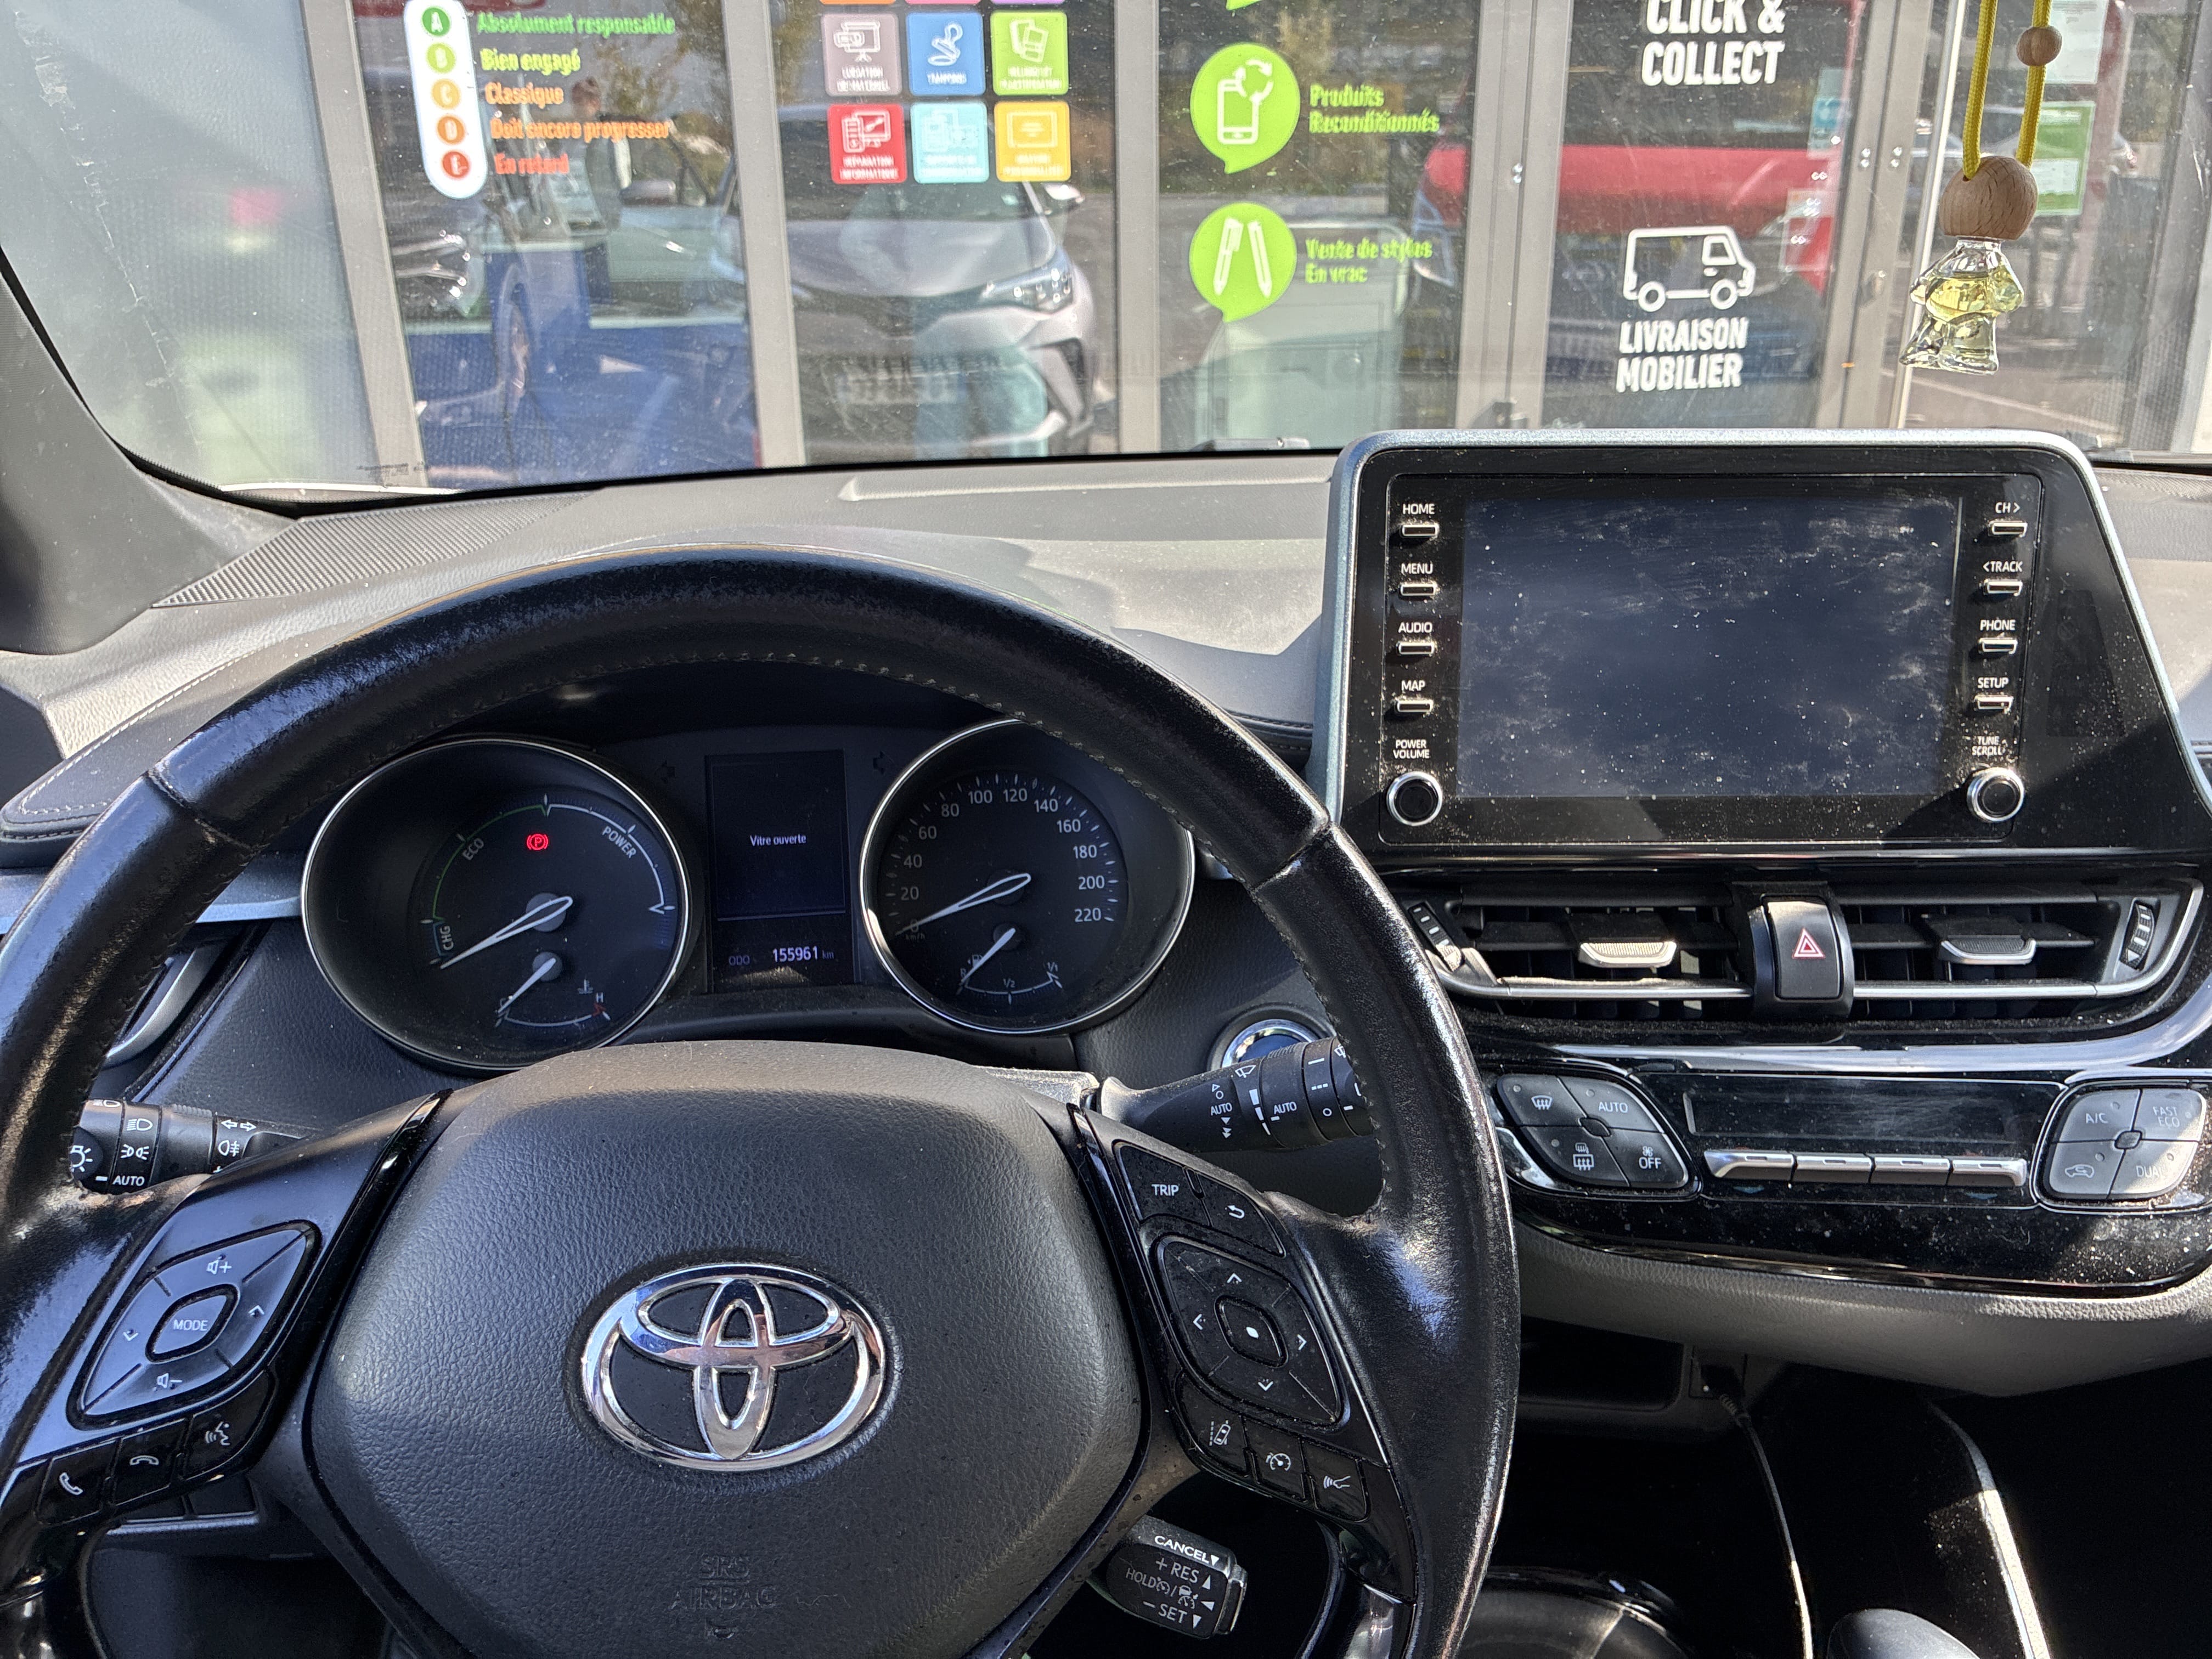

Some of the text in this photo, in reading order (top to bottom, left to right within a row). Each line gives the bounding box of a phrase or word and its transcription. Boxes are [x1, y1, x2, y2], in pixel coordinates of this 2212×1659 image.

[431, 11, 443, 32] A
[1646, 0, 1786, 34] CLICK &
[478, 12, 675, 38] Absolument responsable
[480, 48, 580, 76] Bien engagé
[1641, 41, 1786, 86] COLLECT
[485, 82, 564, 109] Classique
[1310, 83, 1384, 107] Produits
[1309, 108, 1440, 133] Reconditionnés
[490, 117, 669, 143] Doit encore progresser
[495, 153, 569, 174] En retard
[1306, 238, 1354, 259] Vente
[1357, 238, 1379, 259] de
[1306, 265, 1368, 284] En vrac
[1620, 317, 1750, 354] LIVRAISON
[1616, 353, 1743, 393] MOBILIER
[1402, 504, 1435, 515] HOME
[1995, 502, 2011, 514] CH
[1401, 563, 1434, 574] MENU
[1398, 622, 1433, 633] AUDIO
[1980, 619, 2016, 631] PHONE
[1401, 680, 1426, 692] MAP
[1978, 677, 2009, 689] SETUP
[1395, 739, 1426, 749] POWER
[1977, 736, 1999, 746] TUNE
[1393, 749, 1430, 759] VOLUME
[1972, 746, 2002, 756] SCROLL
[968, 789, 993, 804] 100
[1003, 788, 1028, 803] 120
[941, 804, 960, 817] 80
[1034, 799, 1059, 813] 140
[918, 826, 938, 840] 60
[1057, 820, 1082, 834] 160
[601, 826, 637, 860] POWER
[750, 833, 806, 847] Vitre ouverte
[462, 838, 485, 861] ECO
[1073, 845, 1098, 859] 180
[904, 854, 923, 869] 40
[1078, 876, 1105, 890] 200
[900, 887, 919, 901] 20
[1075, 909, 1102, 922] 220
[441, 926, 454, 951] CHG
[729, 946, 834, 966] ODO 155961 km
[1003, 978, 1015, 988] 1/2
[596, 991, 604, 1003] H
[1210, 1102, 1232, 1116] AUTO
[1273, 1101, 1297, 1115] AUTO
[1598, 1102, 1629, 1113] AUTO
[2153, 1107, 2178, 1115] FAST
[2085, 1113, 2108, 1124] A/C
[1639, 1157, 1662, 1169] OFF
[112, 1174, 145, 1187] AUTO
[1152, 1184, 1180, 1197] TRIP
[173, 1319, 208, 1331] MODE
[1154, 1536, 1210, 1564] CANCEL
[1125, 1567, 1156, 1589] HOLD
[1171, 1562, 1199, 1584] RES
[1158, 1603, 1188, 1624] SET
